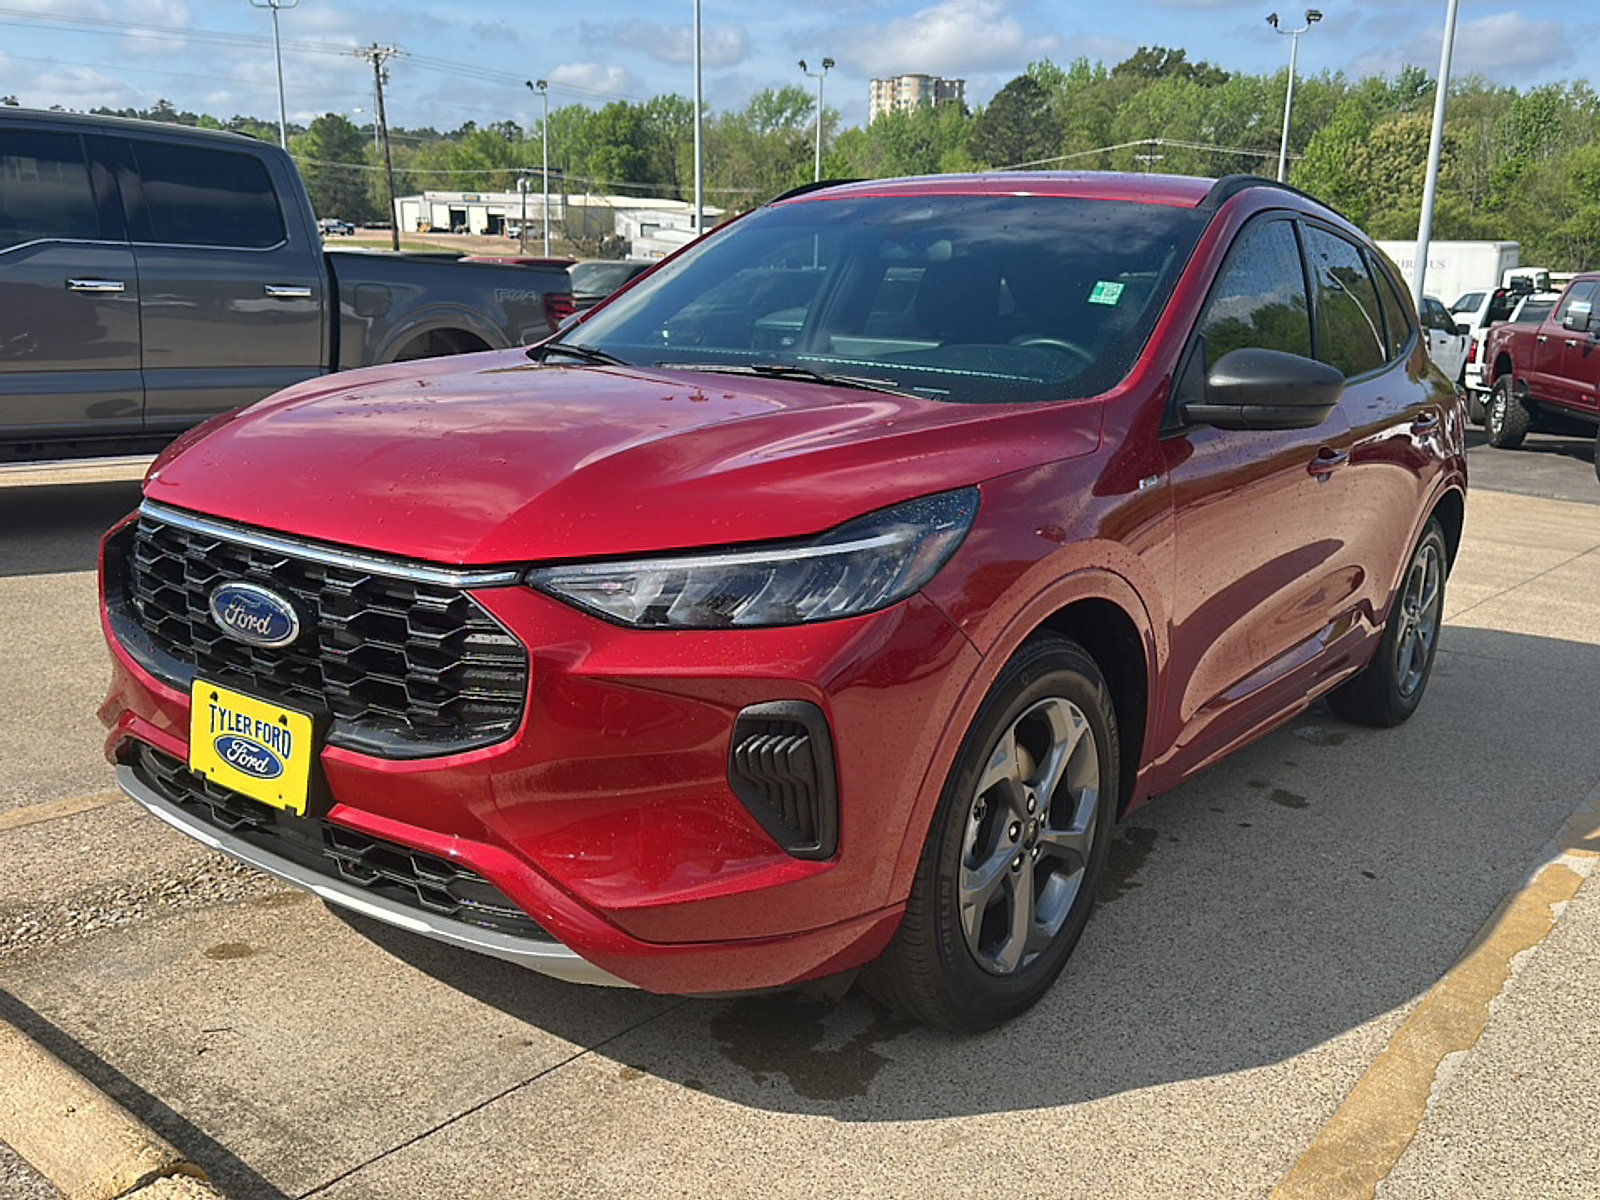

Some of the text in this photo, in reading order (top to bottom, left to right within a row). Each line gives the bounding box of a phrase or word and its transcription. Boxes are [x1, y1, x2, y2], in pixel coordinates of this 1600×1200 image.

[225, 594, 272, 634] Ford
[208, 703, 291, 760] TYLER FORD
[226, 740, 270, 773] Ford
